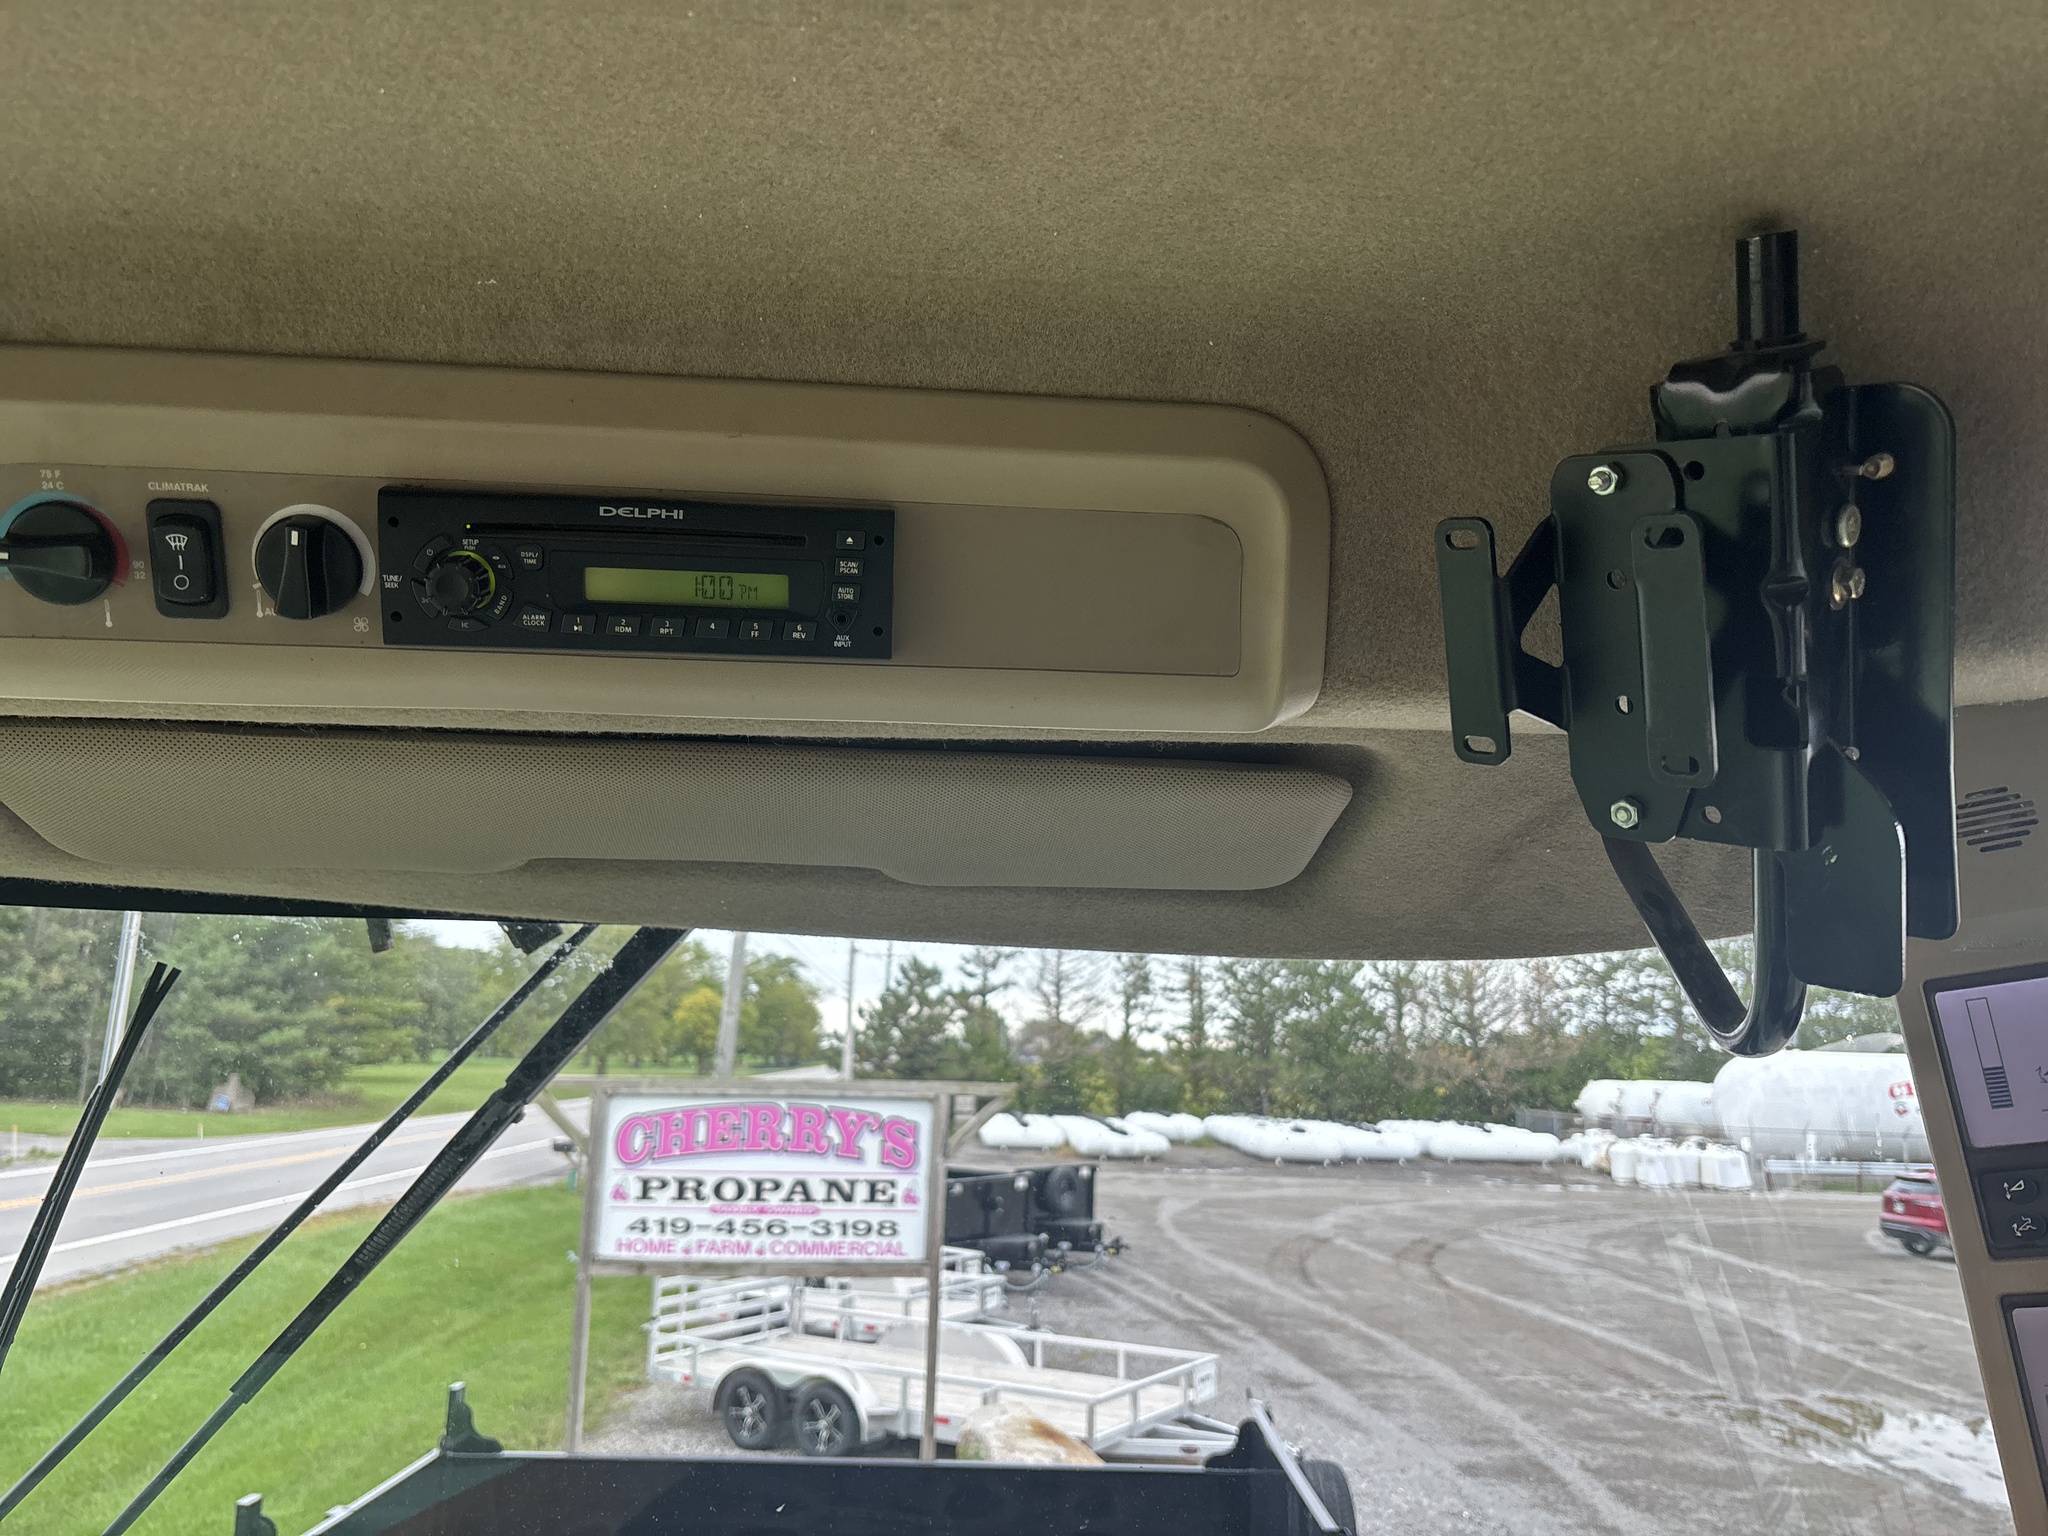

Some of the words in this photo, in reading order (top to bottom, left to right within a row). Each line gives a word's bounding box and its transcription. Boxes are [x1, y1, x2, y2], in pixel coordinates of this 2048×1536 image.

[40, 469, 53, 479] 75
[54, 469, 61, 479] F
[41, 481, 54, 490] 24
[56, 481, 64, 490] C
[147, 481, 209, 493] CLIMATRAK
[599, 506, 684, 520] DELPHI
[462, 538, 480, 546] SETUP
[520, 551, 539, 559] DSPL/
[132, 560, 145, 569] 90
[839, 560, 859, 568] SCAN/
[133, 571, 146, 580] 32
[839, 567, 859, 575] PSCAN
[382, 574, 403, 583] TUNE/
[694, 575, 733, 600] 1:00
[738, 584, 758, 600] PM
[494, 595, 508, 615] BAND
[576, 616, 581, 624] 1
[621, 618, 627, 626] 2
[664, 620, 671, 628] 3
[614, 626, 633, 634] RDM
[709, 622, 716, 630] 4
[797, 624, 803, 632] 6
[659, 628, 674, 636] RPT
[750, 630, 760, 639] FF
[792, 632, 807, 640] REV
[613, 1101, 921, 1170] CHERRY'S
[635, 1174, 898, 1205] PROPANE
[628, 1216, 900, 1238] 419-456-3198
[614, 1237, 677, 1255] HOME
[695, 1239, 754, 1256] FARM
[768, 1239, 907, 1258] COMMERCIAL
